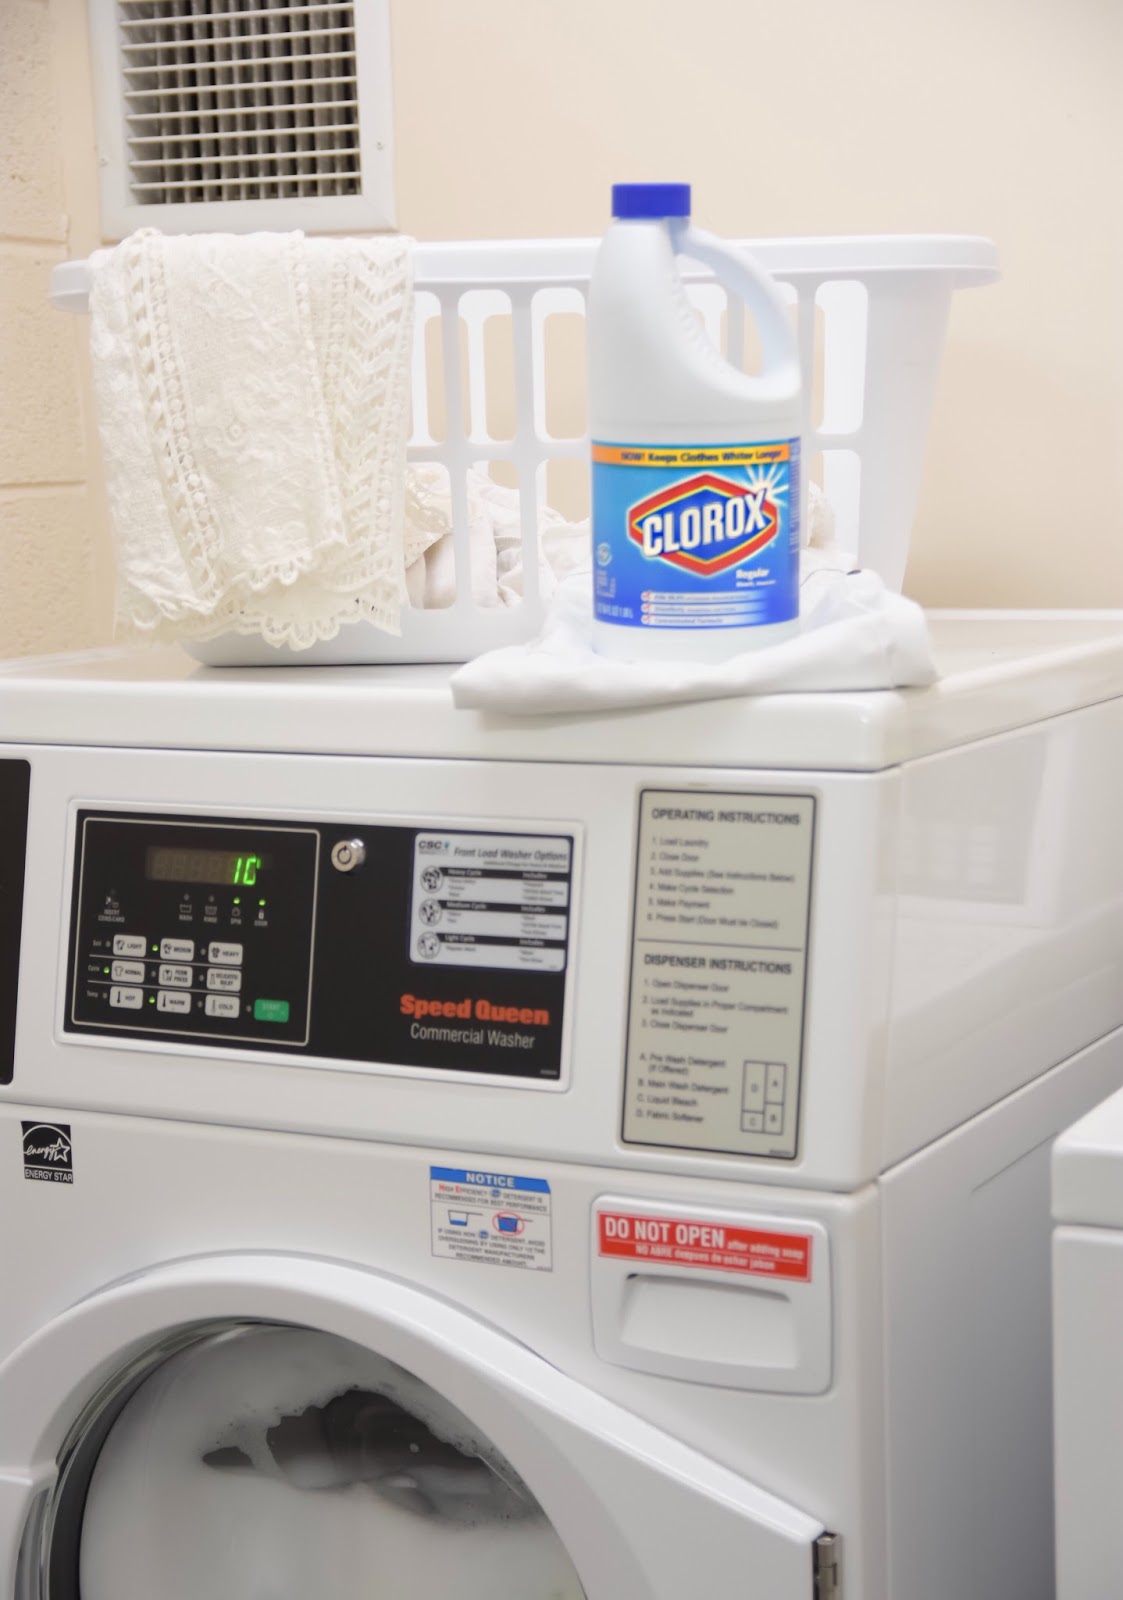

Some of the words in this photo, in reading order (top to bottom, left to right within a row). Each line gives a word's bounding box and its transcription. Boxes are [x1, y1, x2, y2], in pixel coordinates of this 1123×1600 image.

[648, 453, 677, 463] Keeps
[680, 453, 719, 461] Clothes
[722, 452, 753, 460] Whiter
[643, 488, 766, 557] CLOROX
[736, 568, 769, 580] Regular
[652, 808, 714, 821] OPERATING
[718, 811, 800, 825] INSTRUCTIONS
[418, 840, 442, 850] CSC
[454, 847, 476, 857] Front
[478, 849, 498, 858] Load
[501, 850, 532, 860] Washer
[534, 851, 567, 861] Options
[658, 884, 677, 892] Make
[679, 884, 699, 893] Cycle
[702, 886, 733, 894] Selection
[656, 899, 675, 907] Make
[678, 900, 710, 909] Payment
[656, 914, 676, 922] Press
[678, 915, 695, 923] Start
[644, 954, 706, 968] DISPENSER
[709, 958, 792, 974] INSTRUCTIONS
[125, 969, 142, 977] NORMAL
[652, 980, 671, 989] Open
[673, 981, 709, 991] Dispenser
[712, 984, 729, 992] Door
[400, 994, 472, 1019] Speed
[475, 1000, 550, 1025] Queen
[662, 1009, 693, 1017] Indicated
[738, 1002, 788, 1014] Compartment
[672, 1022, 708, 1032] Dispenser
[710, 1025, 728, 1033] Door
[410, 1023, 484, 1045] Commercial
[488, 1030, 535, 1049] Washer
[665, 1055, 686, 1063] Wash
[688, 1058, 726, 1068] Detergent
[648, 1080, 666, 1088] Main
[668, 1082, 689, 1090] Wash
[691, 1083, 728, 1094] Detergent
[772, 1080, 778, 1088] A
[647, 1095, 669, 1104] Liquid
[647, 1111, 669, 1120] Fabric
[672, 1112, 703, 1122] Softener
[25, 1169, 52, 1179] ENERGY
[54, 1172, 73, 1182] STAR
[466, 1172, 515, 1187] NOTICE
[434, 1192, 476, 1203] RECOMMENDED
[503, 1192, 536, 1202] DETERGENT
[444, 1228, 461, 1236] USING
[605, 1217, 629, 1238] DO
[635, 1220, 670, 1243] NOT
[676, 1224, 724, 1248] OPEN
[728, 1241, 748, 1251] after
[751, 1244, 779, 1257] adding
[782, 1249, 804, 1260] soap
[449, 1244, 482, 1253] DETERGENT
[489, 1241, 507, 1249] USING
[456, 1252, 500, 1264] RECOMMENDED
[635, 1244, 648, 1256] NO
[711, 1253, 722, 1263] de
